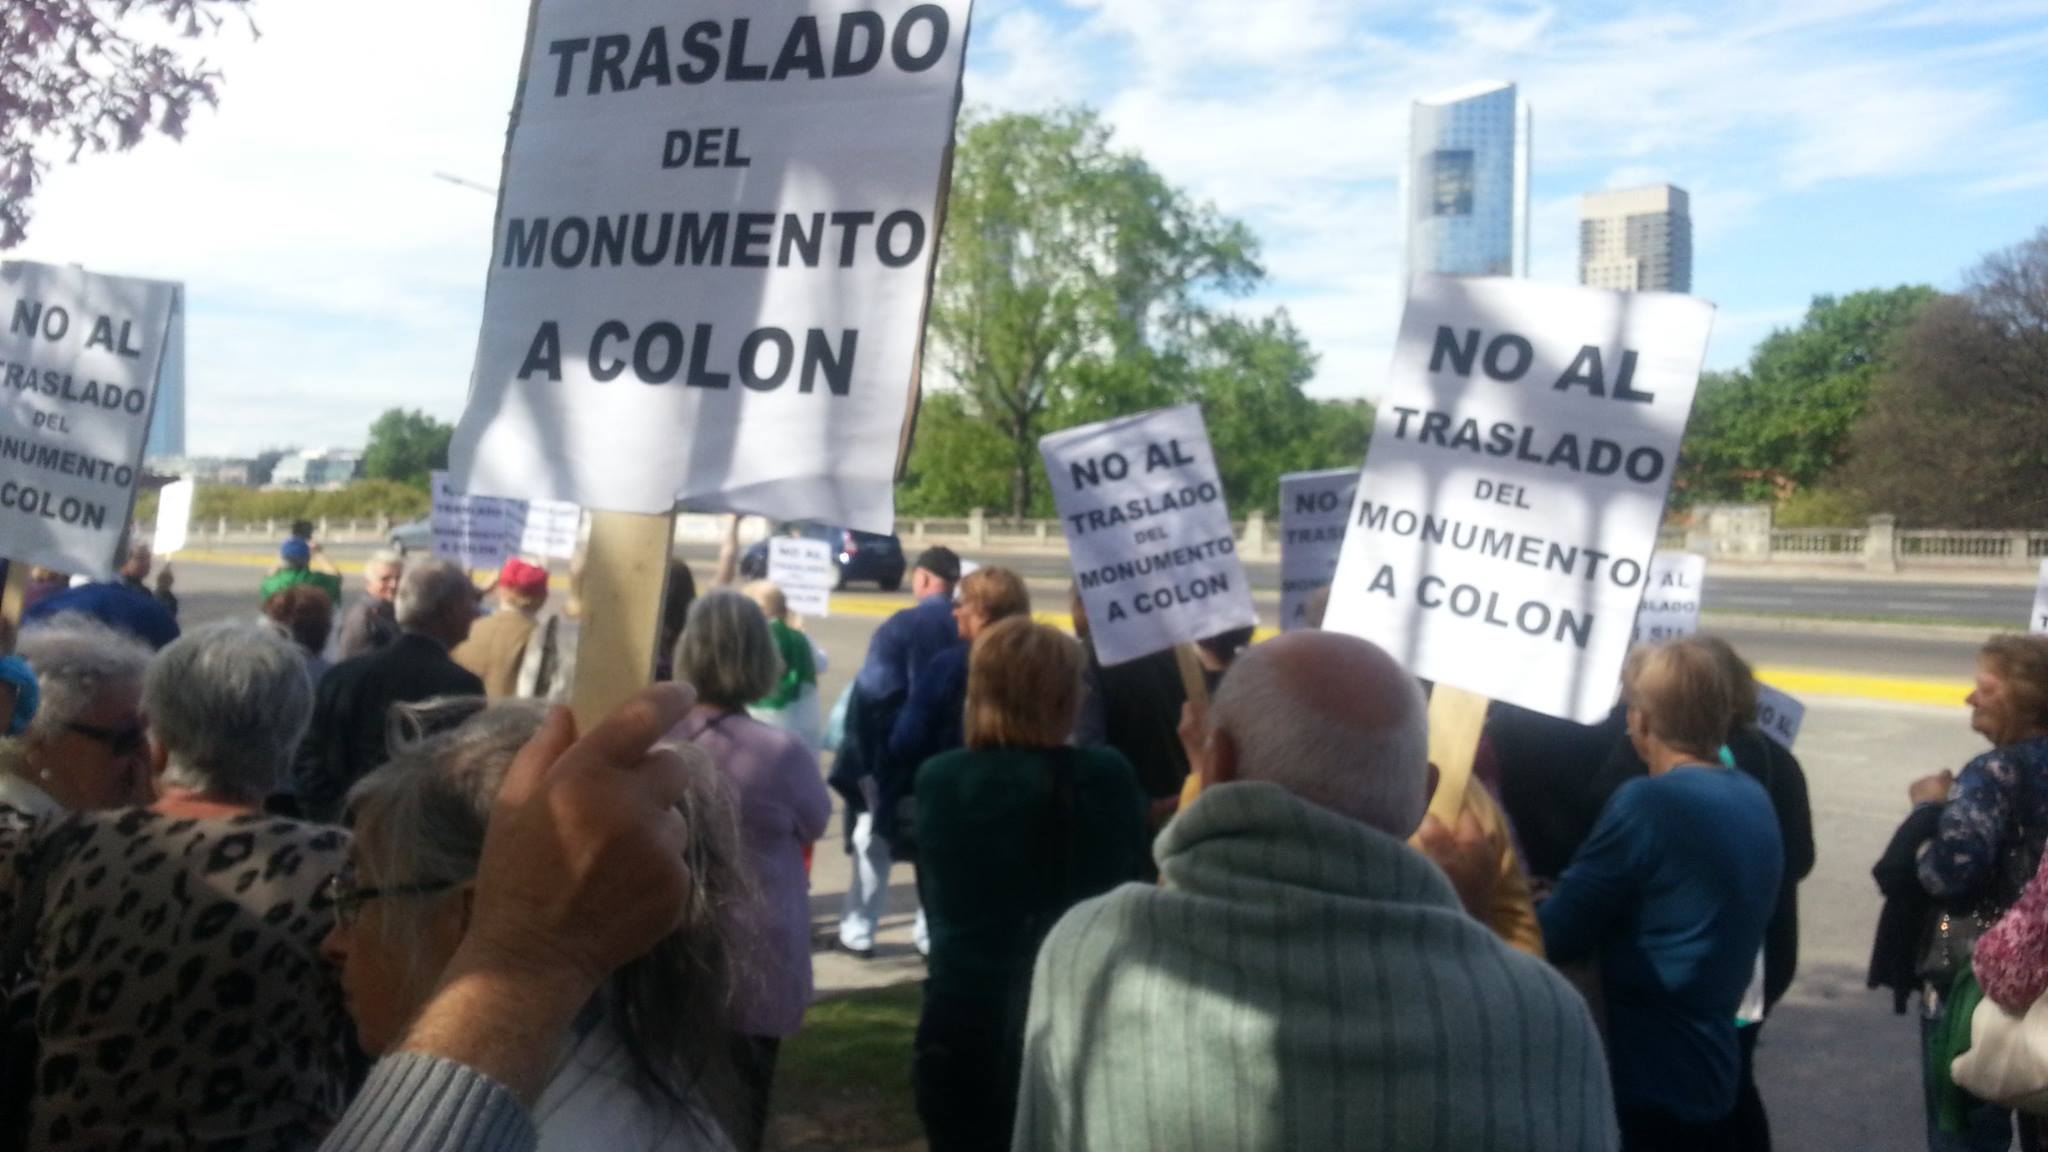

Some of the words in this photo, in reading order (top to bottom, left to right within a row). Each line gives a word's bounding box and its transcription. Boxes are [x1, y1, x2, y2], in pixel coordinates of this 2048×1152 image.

[549, 4, 950, 97] TRASLADO
[662, 128, 751, 169] DEL
[502, 209, 926, 269] MONUMENTO
[10, 299, 69, 342] NO
[84, 314, 141, 359] AL
[517, 320, 563, 382] A
[587, 319, 859, 396] COLON
[1428, 325, 1534, 382] NO
[1553, 344, 1655, 405] AL
[33, 410, 69, 434] DEL
[1392, 406, 1665, 484] TRASLADO
[0, 434, 132, 488] NUMENTO
[1069, 452, 1129, 491] NO
[1145, 438, 1195, 473] AL
[0, 481, 105, 530] COLON
[1068, 482, 1218, 536] TRASLADO
[1295, 490, 1338, 514] NO
[1474, 478, 1531, 510] DEL
[1134, 527, 1169, 546] DEL
[1357, 500, 1642, 588] MONUMENTO
[1080, 537, 1235, 590] MONUMENTO
[1661, 571, 1691, 589] AL
[1107, 601, 1127, 623] A
[1134, 573, 1230, 615] COLON
[1366, 564, 1396, 599] A
[1416, 575, 1595, 649] COLON
